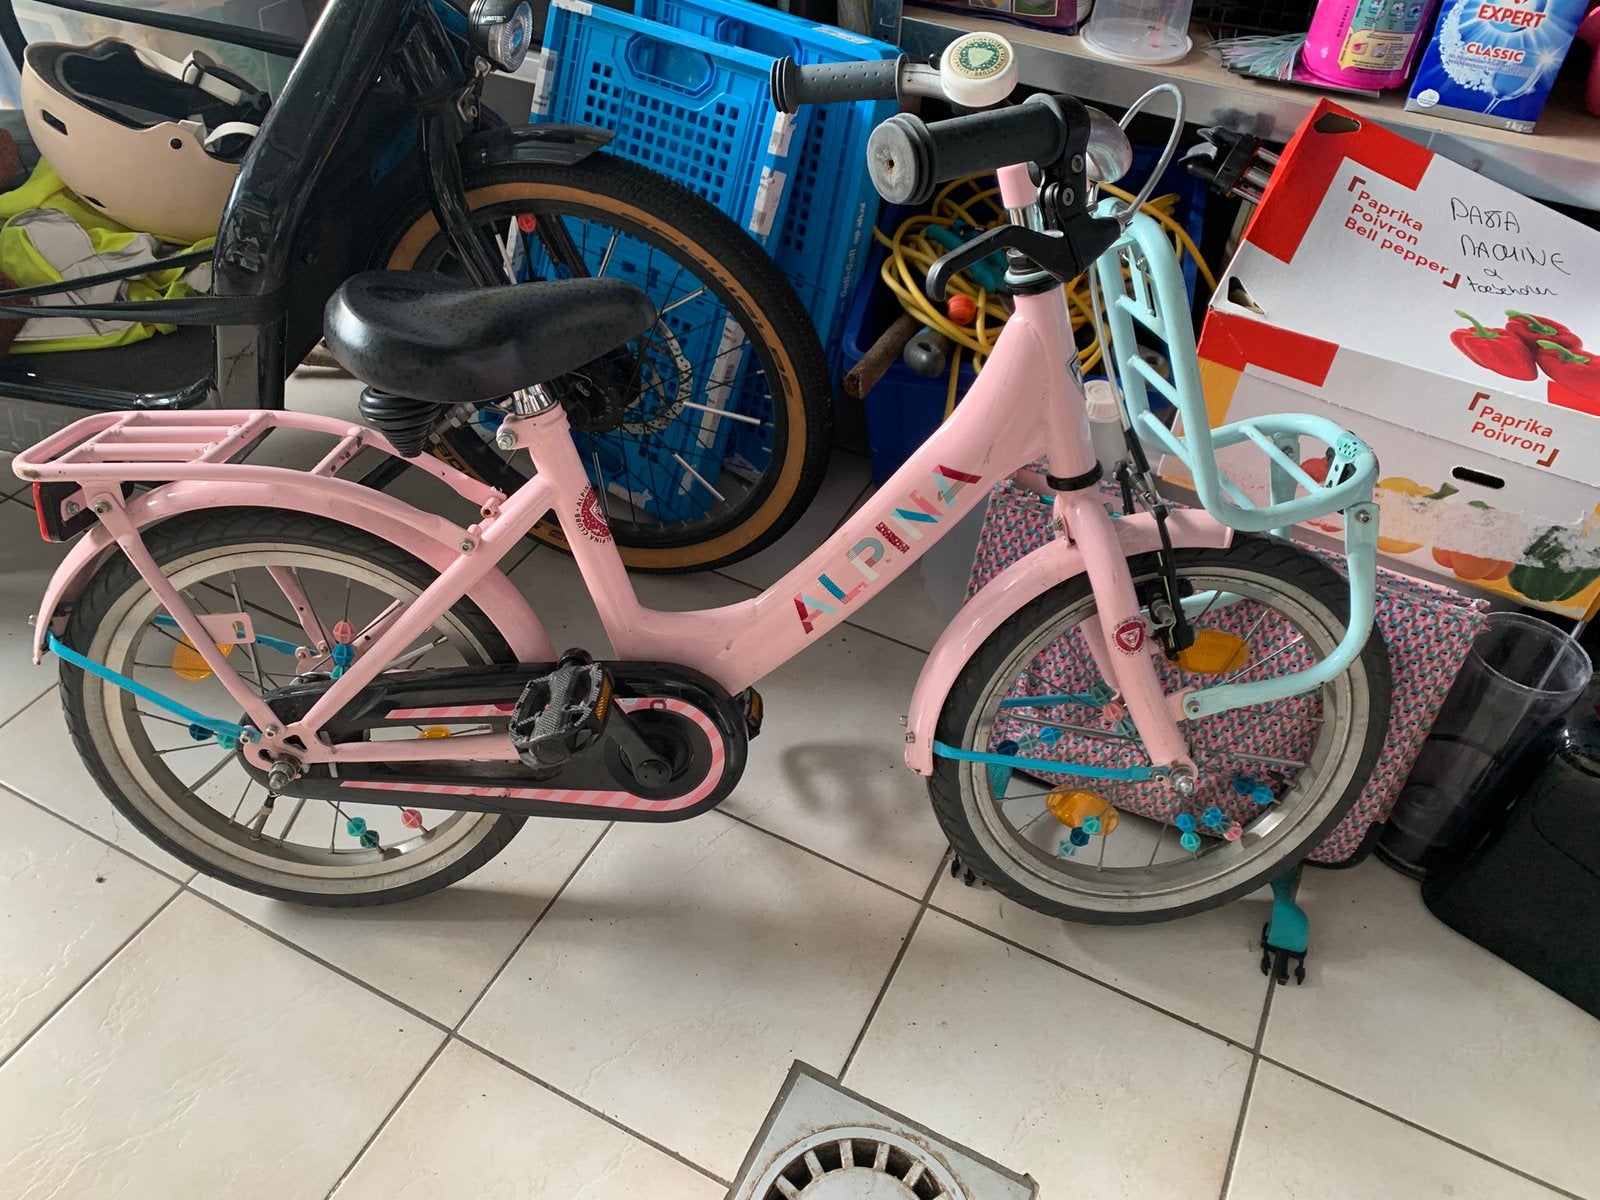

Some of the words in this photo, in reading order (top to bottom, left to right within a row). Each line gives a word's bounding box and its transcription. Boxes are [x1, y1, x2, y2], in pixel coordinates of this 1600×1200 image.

[1478, 4, 1546, 28] EXPERT
[1466, 43, 1524, 62] CLASSIC
[1351, 203, 1419, 246] Poivron
[1357, 190, 1423, 231] Paprika
[1344, 216, 1378, 242] Bell
[1380, 238, 1450, 274] pepper
[1471, 421, 1546, 454] Poivron
[1479, 405, 1553, 438] Paprika
[793, 464, 983, 635] ALPINA
